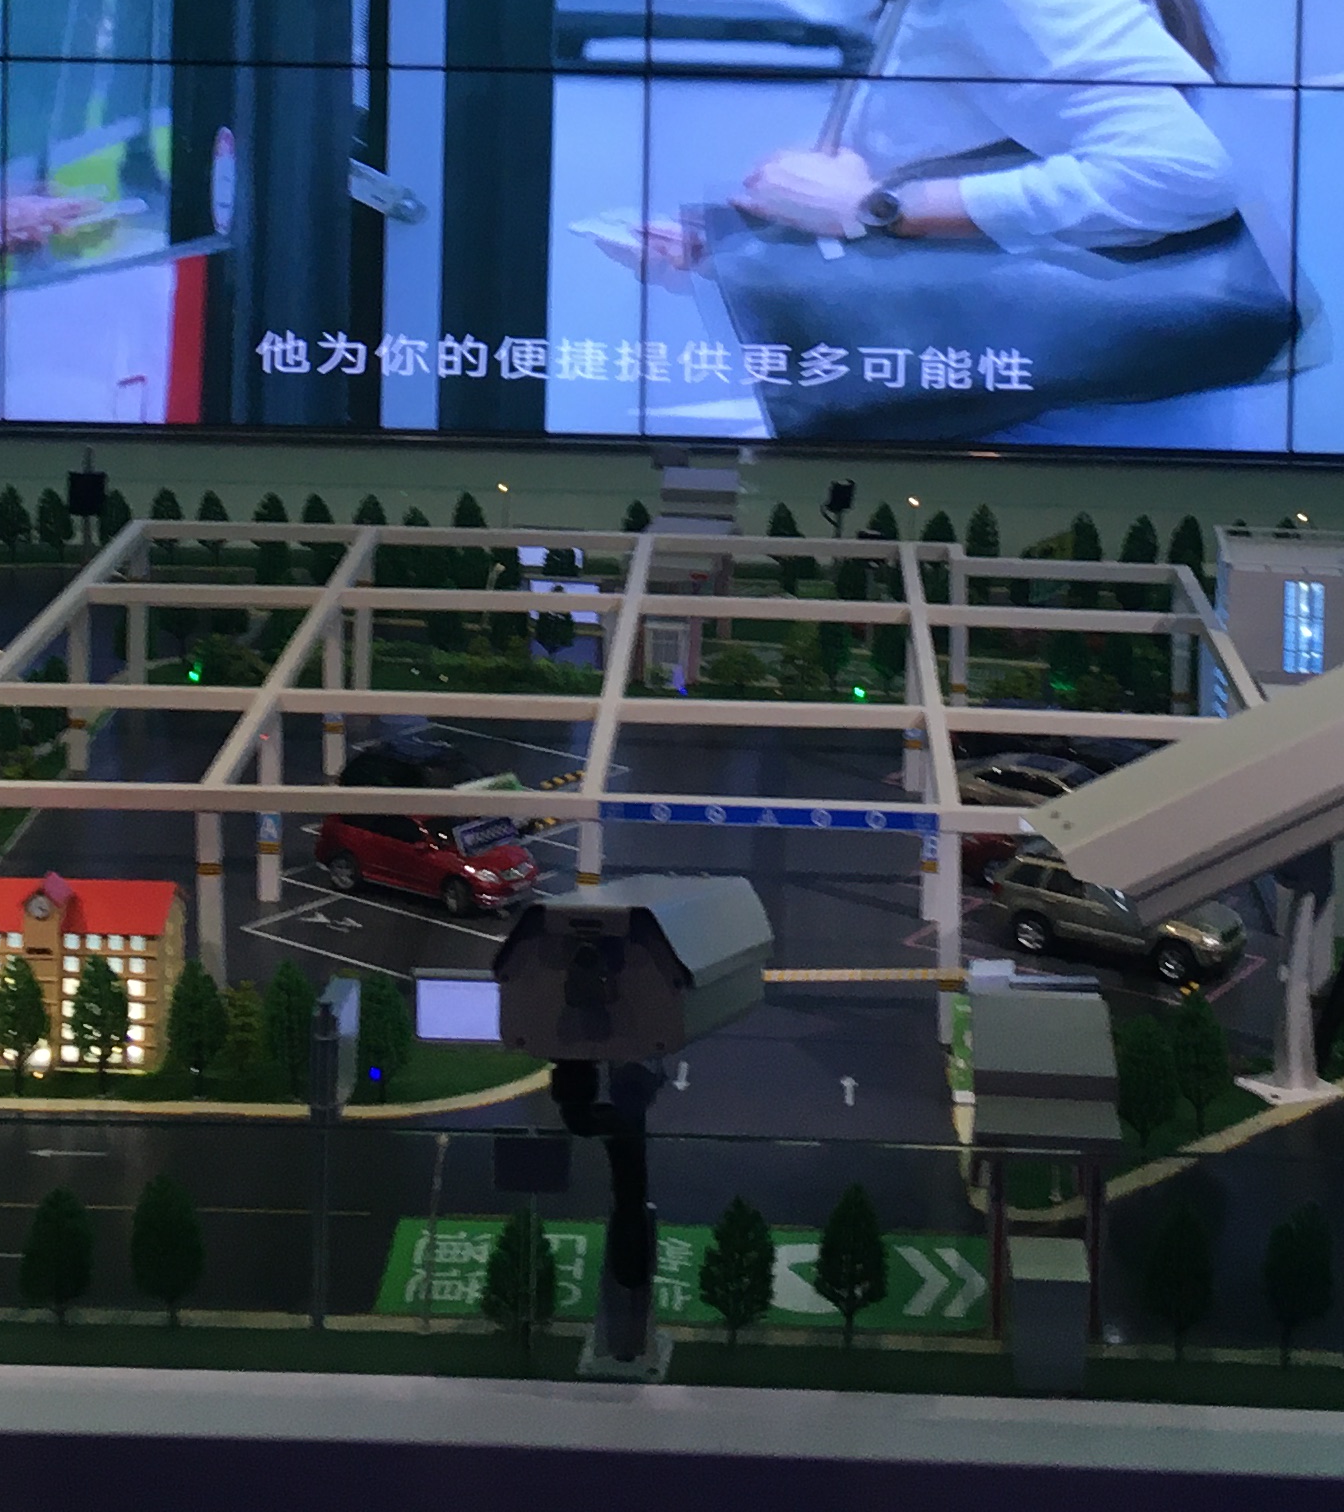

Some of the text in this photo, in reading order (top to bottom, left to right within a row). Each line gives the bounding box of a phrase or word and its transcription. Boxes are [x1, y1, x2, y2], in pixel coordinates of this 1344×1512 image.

[255, 330, 1035, 391] 他为你的便捷提供更多可能性
